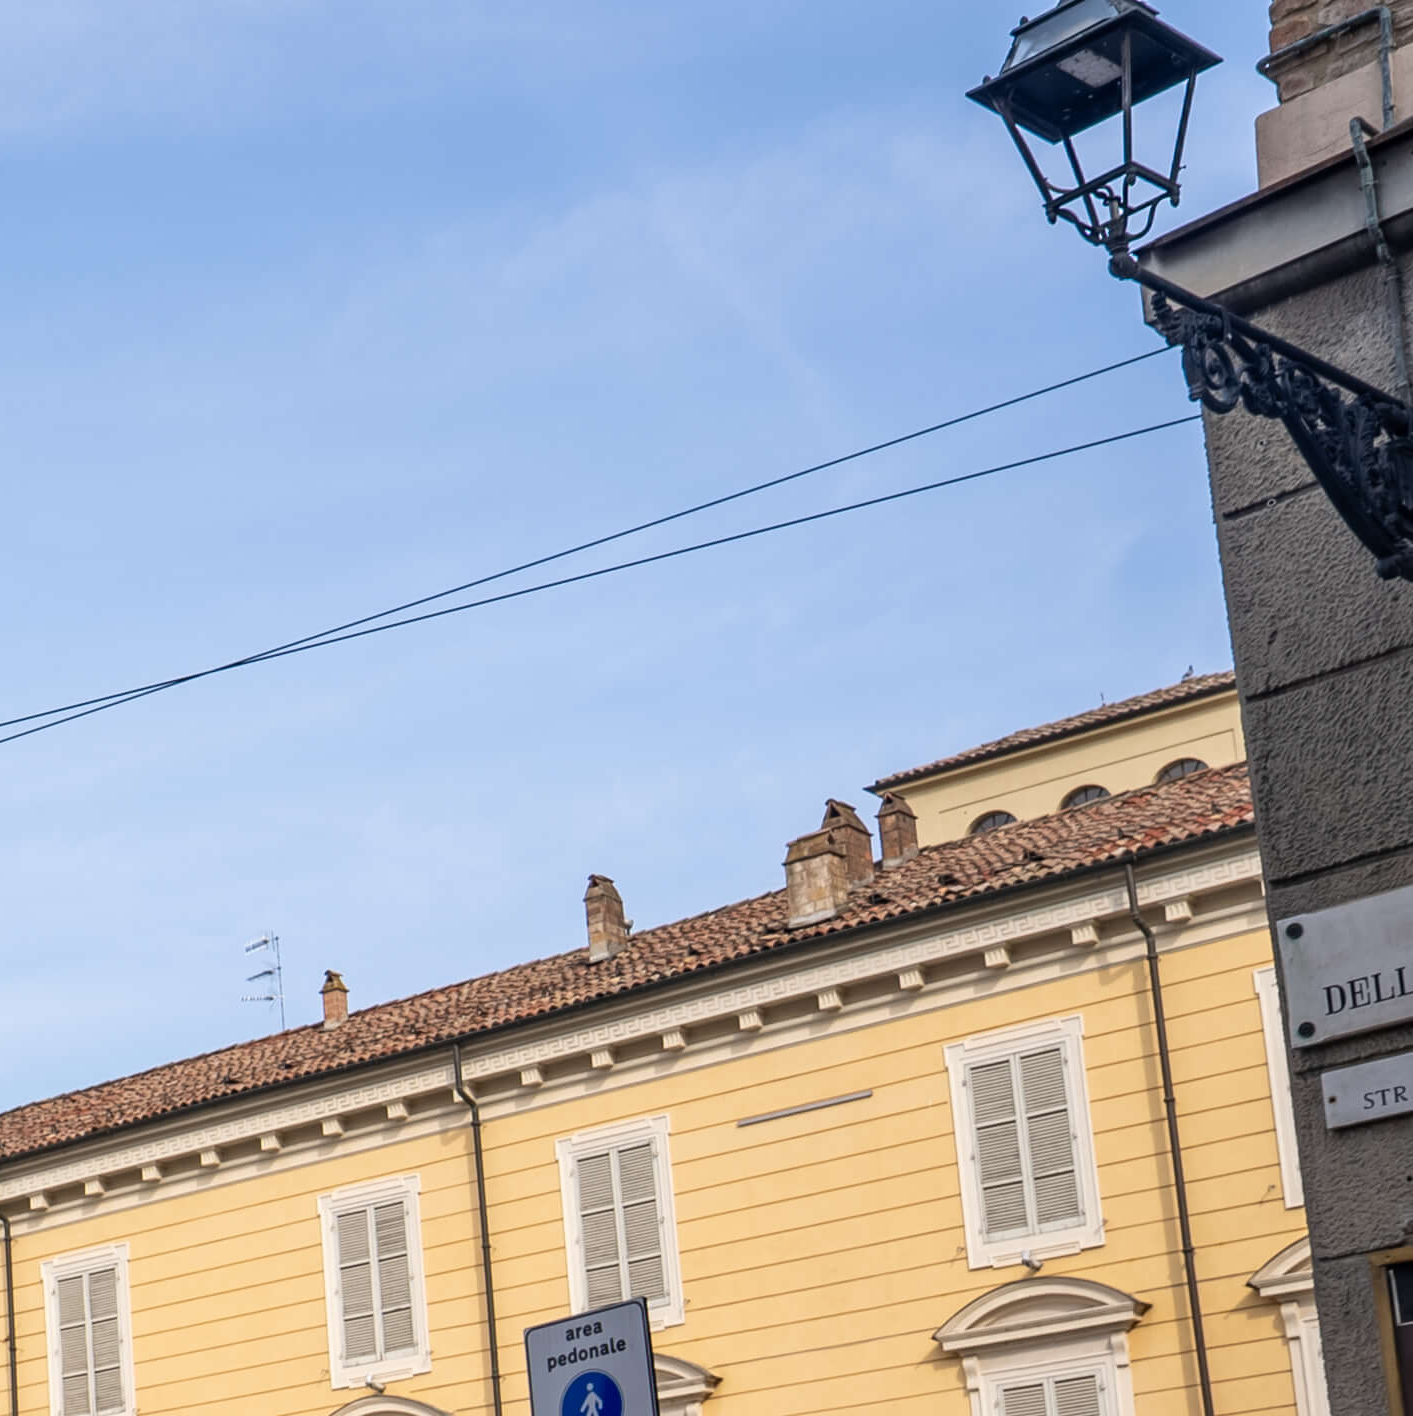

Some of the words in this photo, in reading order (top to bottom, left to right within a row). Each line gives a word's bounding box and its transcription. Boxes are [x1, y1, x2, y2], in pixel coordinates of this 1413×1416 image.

[1323, 966, 1413, 1015] DELL
[566, 1321, 603, 1341] area
[547, 1338, 627, 1372] pedonale
